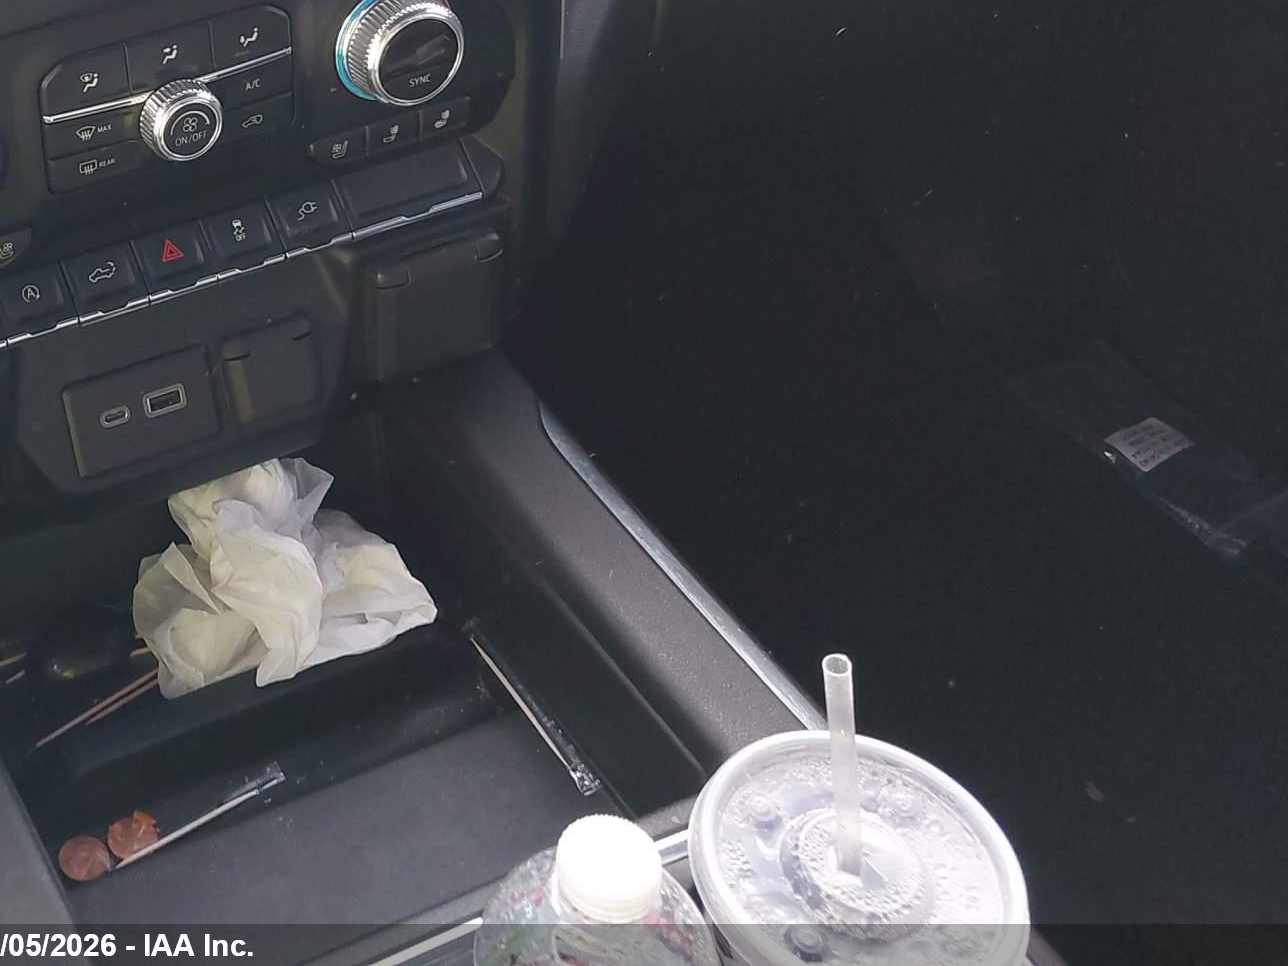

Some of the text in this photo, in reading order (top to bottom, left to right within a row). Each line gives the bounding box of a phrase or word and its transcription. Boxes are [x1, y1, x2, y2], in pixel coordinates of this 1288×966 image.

[245, 78, 261, 91] A/C
[408, 74, 432, 88] SYNC
[97, 124, 112, 133] MAX
[175, 130, 209, 147] ON/OFF
[98, 158, 116, 168] REAR
[235, 233, 247, 241] OFF
